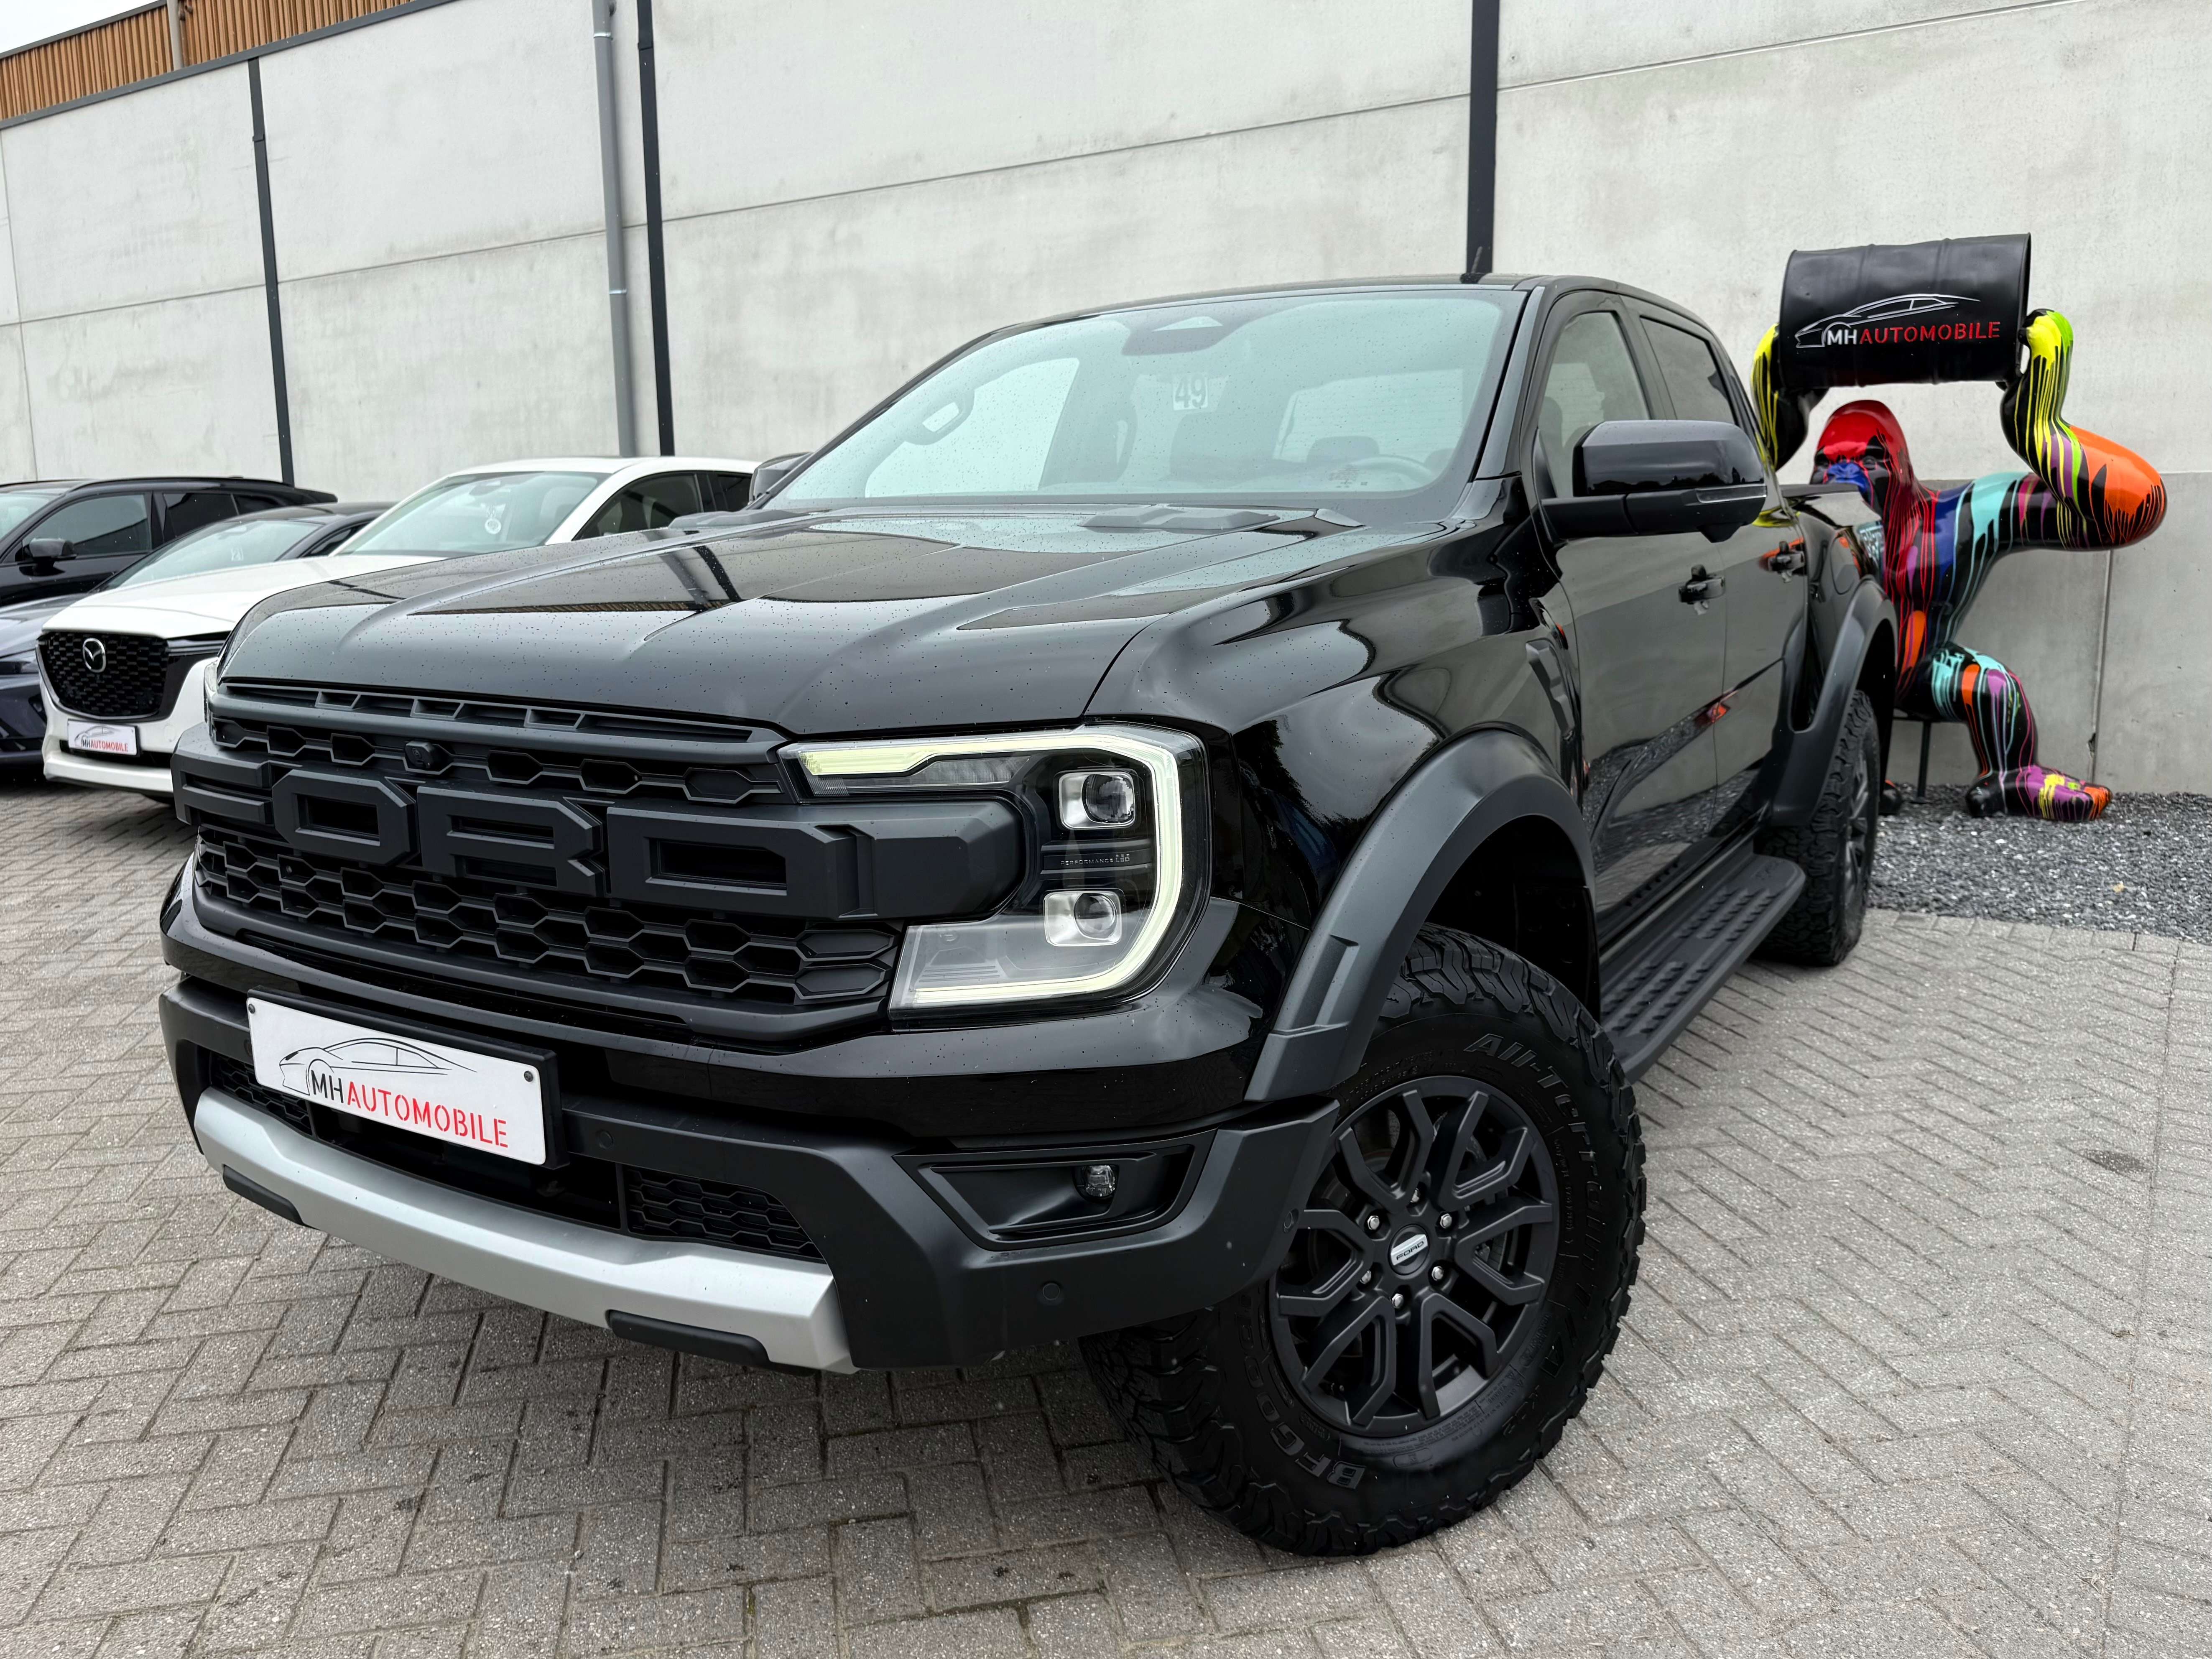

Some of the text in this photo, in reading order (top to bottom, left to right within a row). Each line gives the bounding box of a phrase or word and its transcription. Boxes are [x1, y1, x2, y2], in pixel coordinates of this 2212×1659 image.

[1174, 375, 1207, 408] 49
[170, 752, 837, 920] FORD
[1396, 1241, 1424, 1261] FORD
